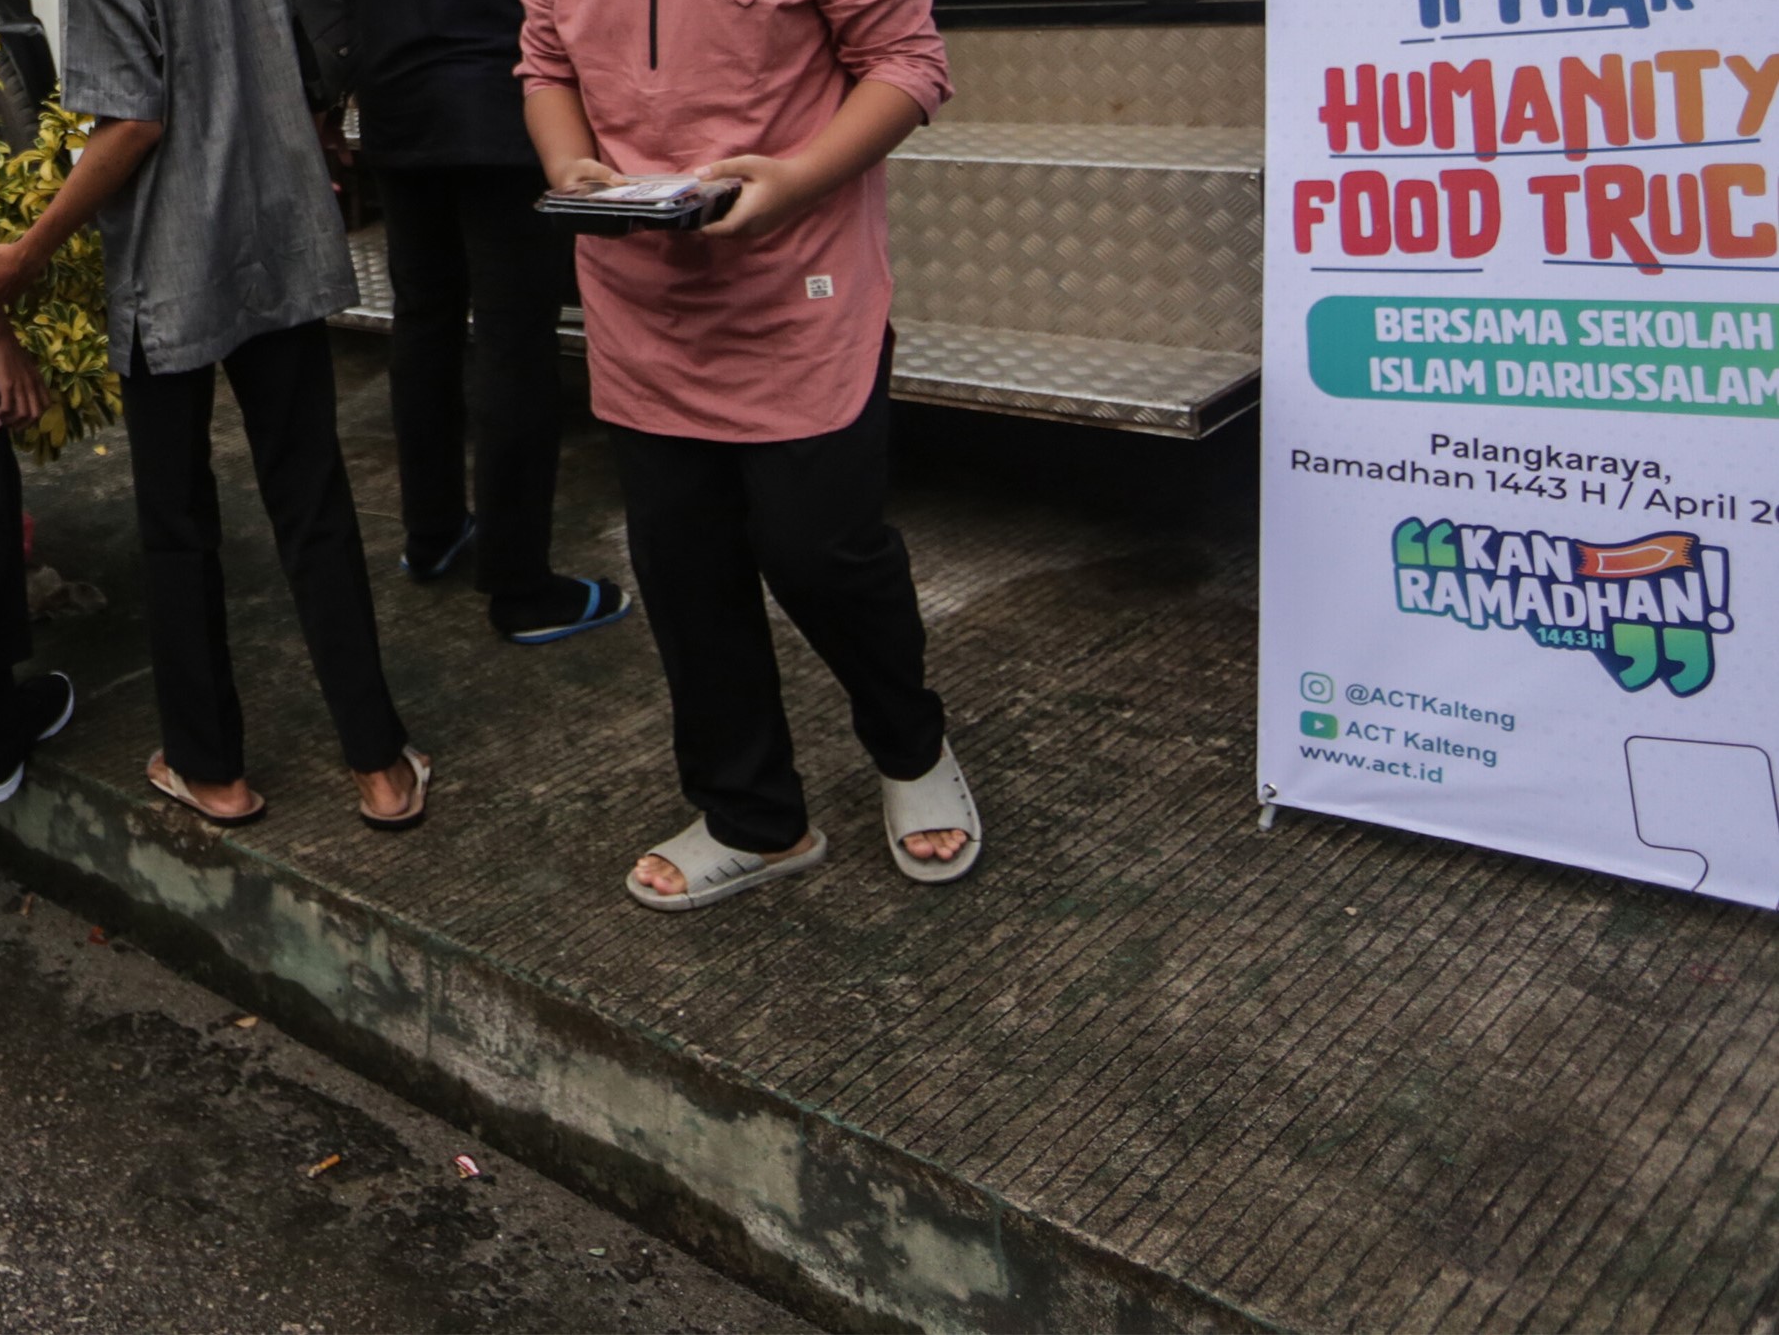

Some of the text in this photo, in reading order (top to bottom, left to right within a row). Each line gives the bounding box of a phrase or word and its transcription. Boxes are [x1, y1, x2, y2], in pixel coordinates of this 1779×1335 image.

[1319, 49, 1779, 162] HUMANITY
[1293, 163, 1779, 275] FOOD TRUC
[1374, 307, 1773, 350] BERSAMA SEKOLAH
[1369, 357, 1779, 406] ISLAM DARUSSALAM
[1430, 433, 1672, 484] Palangkaraya,
[1291, 449, 1475, 490] Ramadhan
[1486, 469, 1568, 500] 1443
[1581, 481, 1606, 505] H
[1618, 481, 1634, 510] /
[1644, 488, 1736, 520] April
[1345, 683, 1516, 732] @ACTKalteng
[1299, 744, 1444, 785] www.act.id
[1345, 720, 1499, 768] ACT Kalteng
